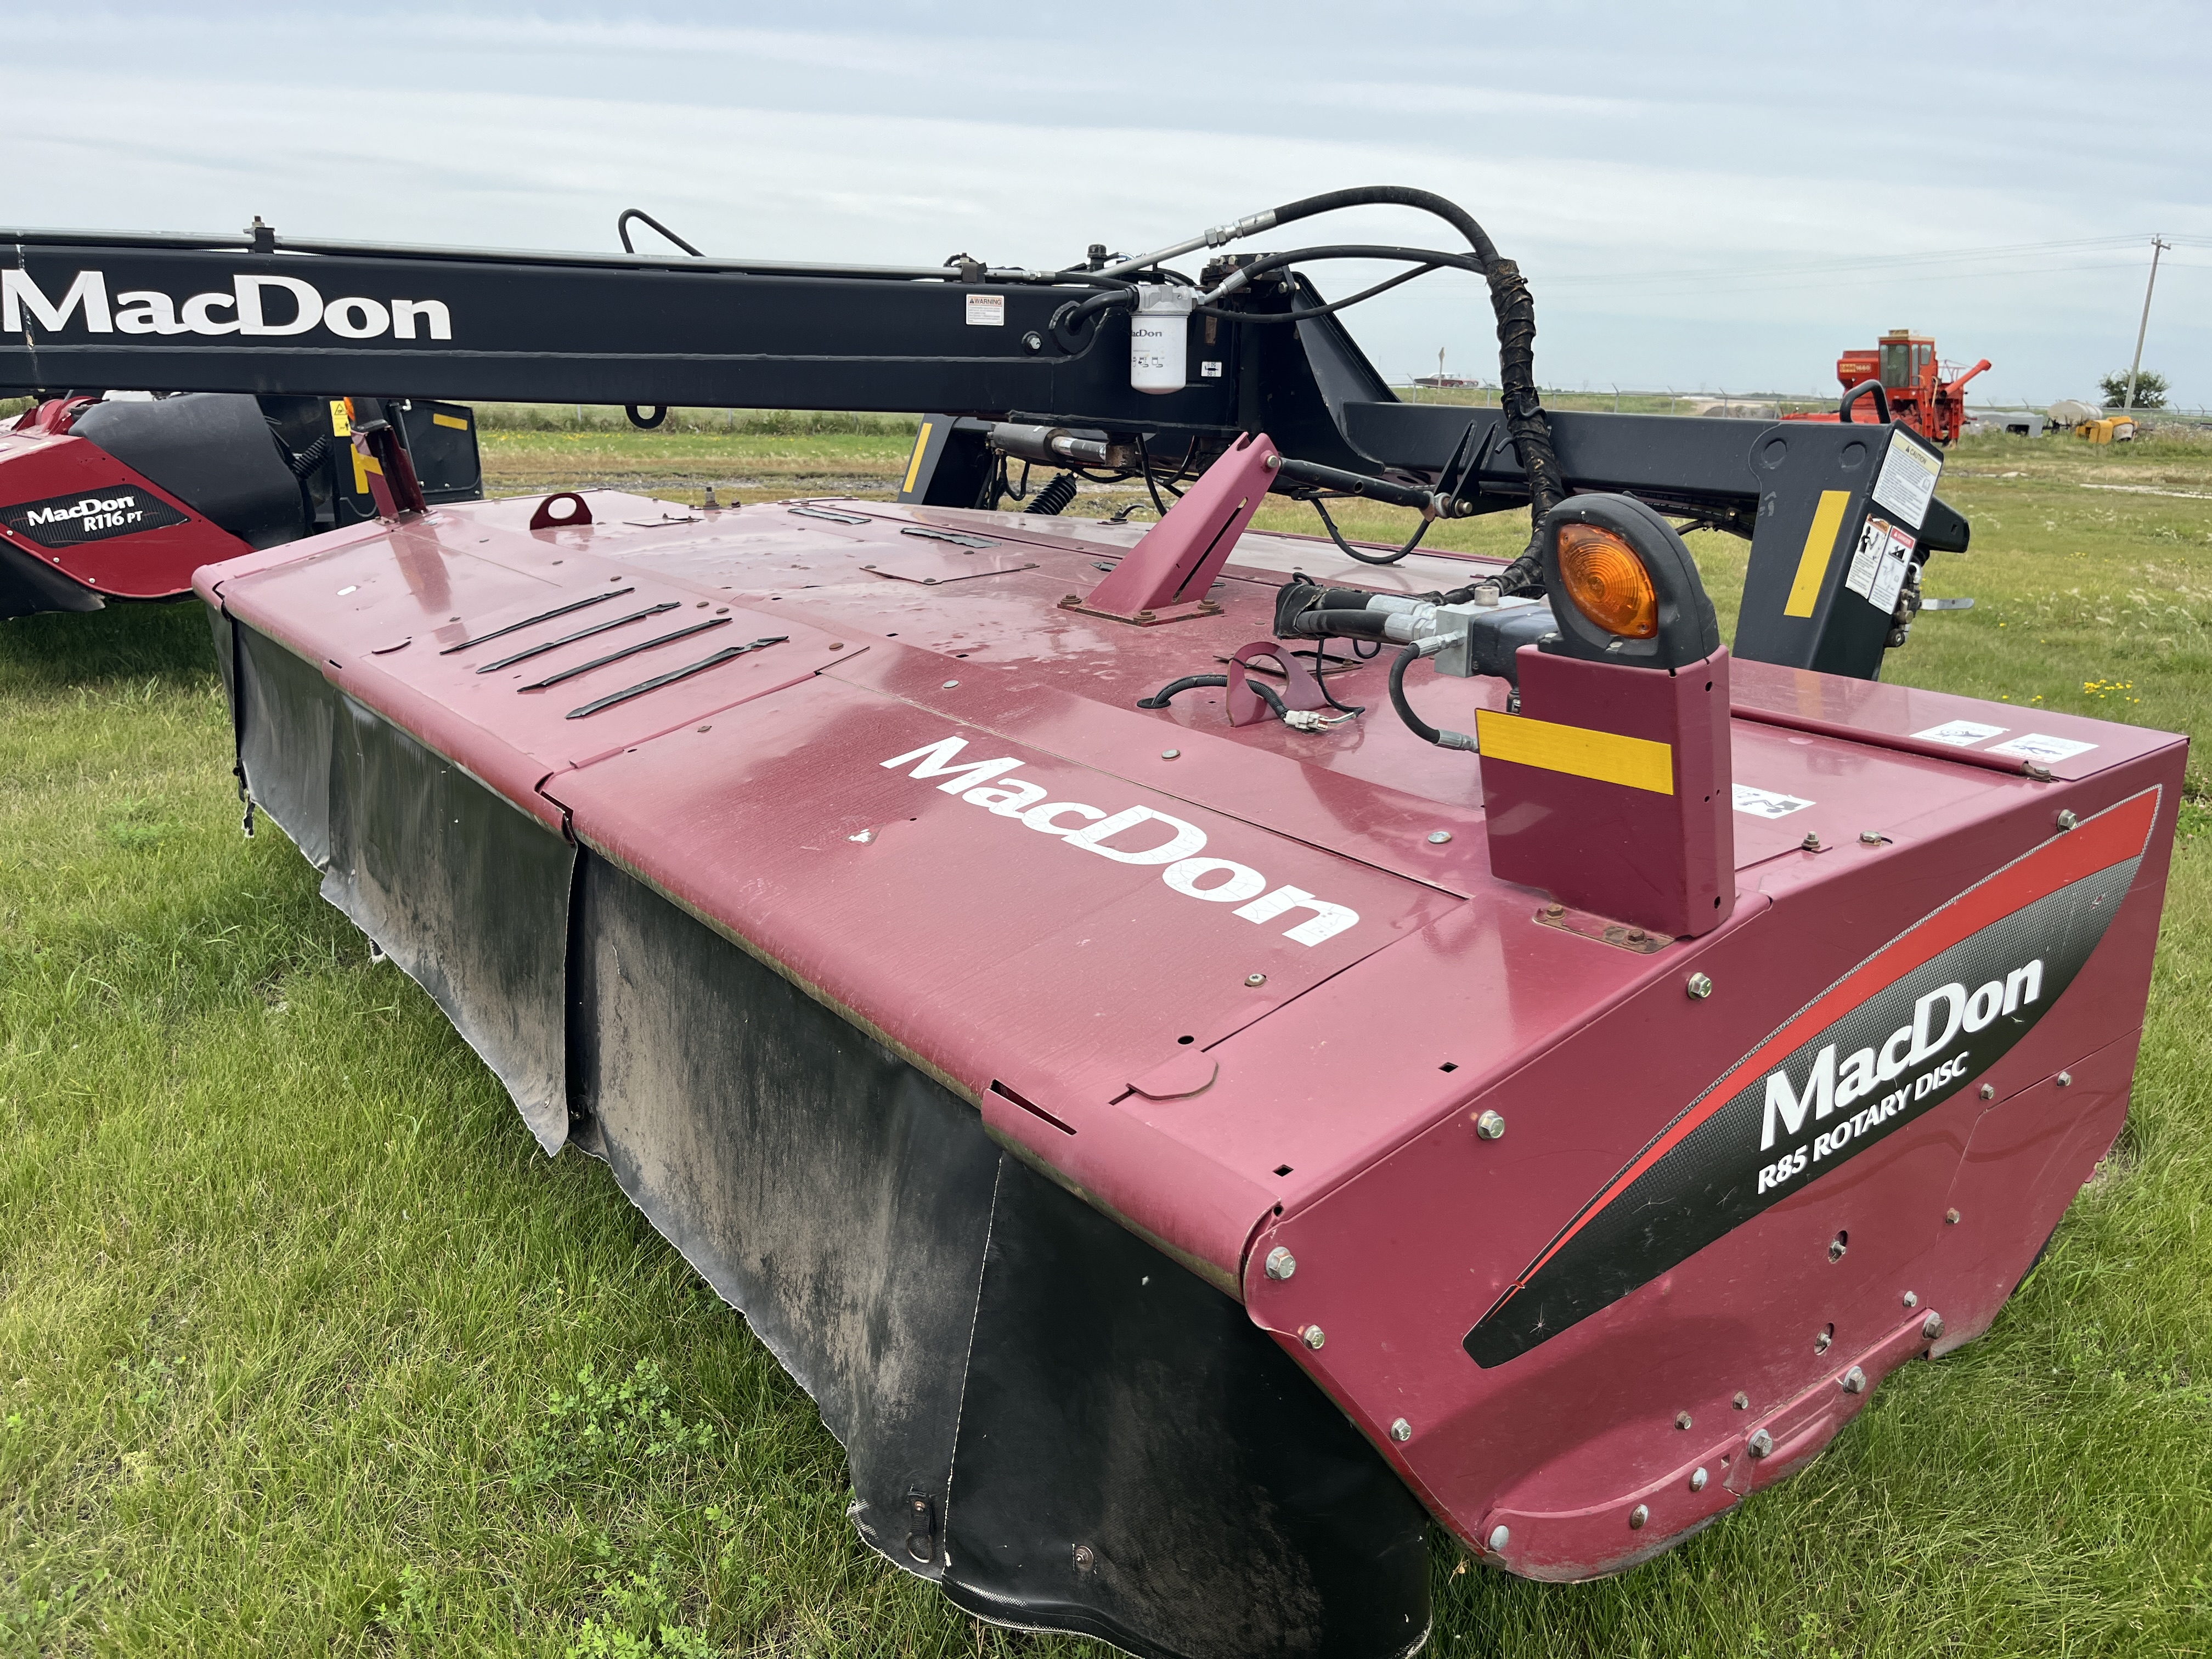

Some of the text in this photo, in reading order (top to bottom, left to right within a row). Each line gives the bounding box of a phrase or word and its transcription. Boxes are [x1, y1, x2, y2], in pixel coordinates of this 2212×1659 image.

[1, 269, 452, 340] MacDon
[1910, 448, 1927, 465] CAUTION
[27, 496, 135, 527] MacDon
[83, 510, 143, 532] R116 PT
[879, 735, 1360, 947] MacDon
[1759, 958, 2043, 1152] MacDon
[1757, 1051, 1970, 1195] R85 ROTARY DISC
